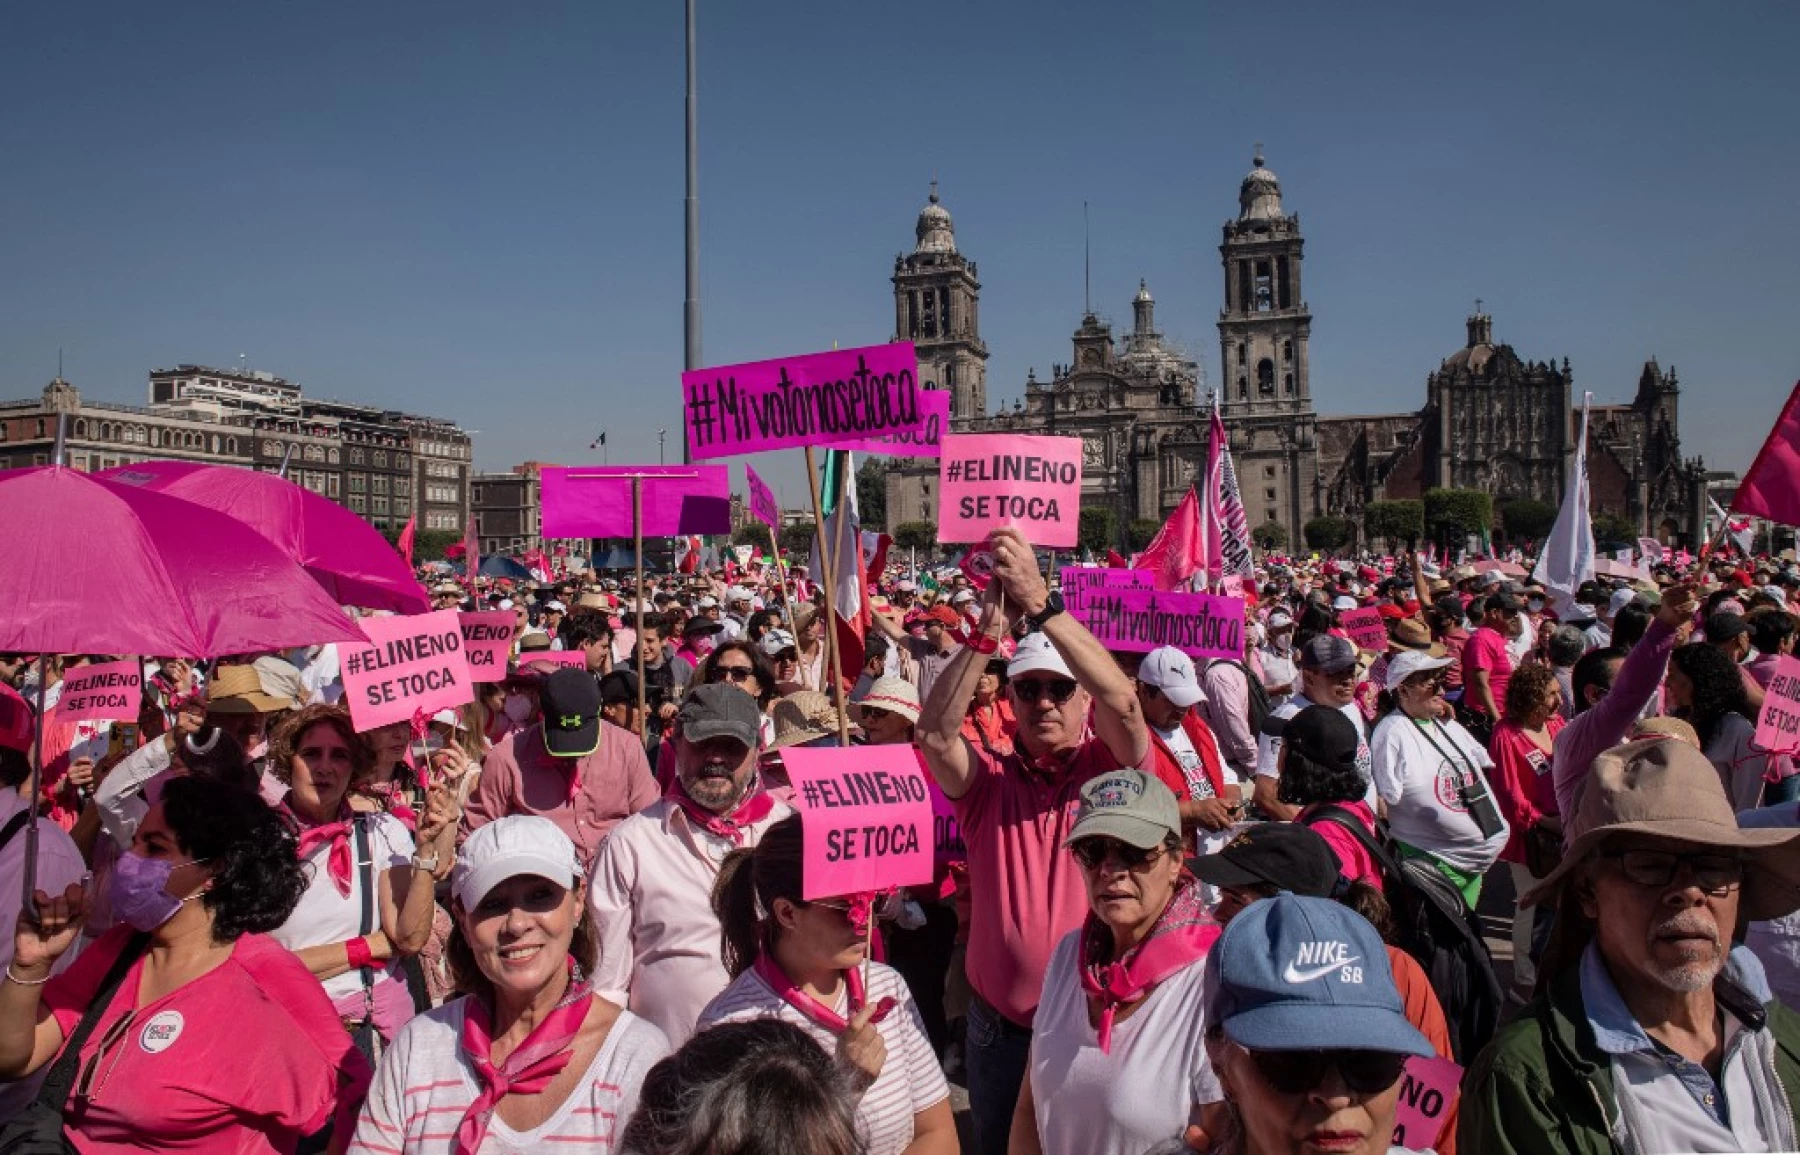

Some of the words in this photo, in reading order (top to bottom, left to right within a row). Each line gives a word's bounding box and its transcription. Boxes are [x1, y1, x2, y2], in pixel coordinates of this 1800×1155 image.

[689, 355, 922, 447] #Mivotonosetoca
[947, 455, 1077, 485] #ELINENO
[960, 496, 990, 519] SE
[995, 496, 1061, 522] TOCA
[1087, 596, 1239, 651] #Mivotonosetoca
[347, 631, 460, 676] #ELINENO
[64, 673, 139, 693] #ELINENO
[67, 697, 86, 711] SE
[89, 693, 127, 708] TOCA
[366, 680, 397, 706] SE
[397, 667, 456, 697] TOCA
[802, 771, 926, 809] #ELINENO
[826, 829, 858, 862] SE
[862, 823, 919, 859] TOCA
[1296, 940, 1348, 966] NIKE
[1340, 966, 1363, 984] SB
[1399, 1068, 1443, 1118] NO
